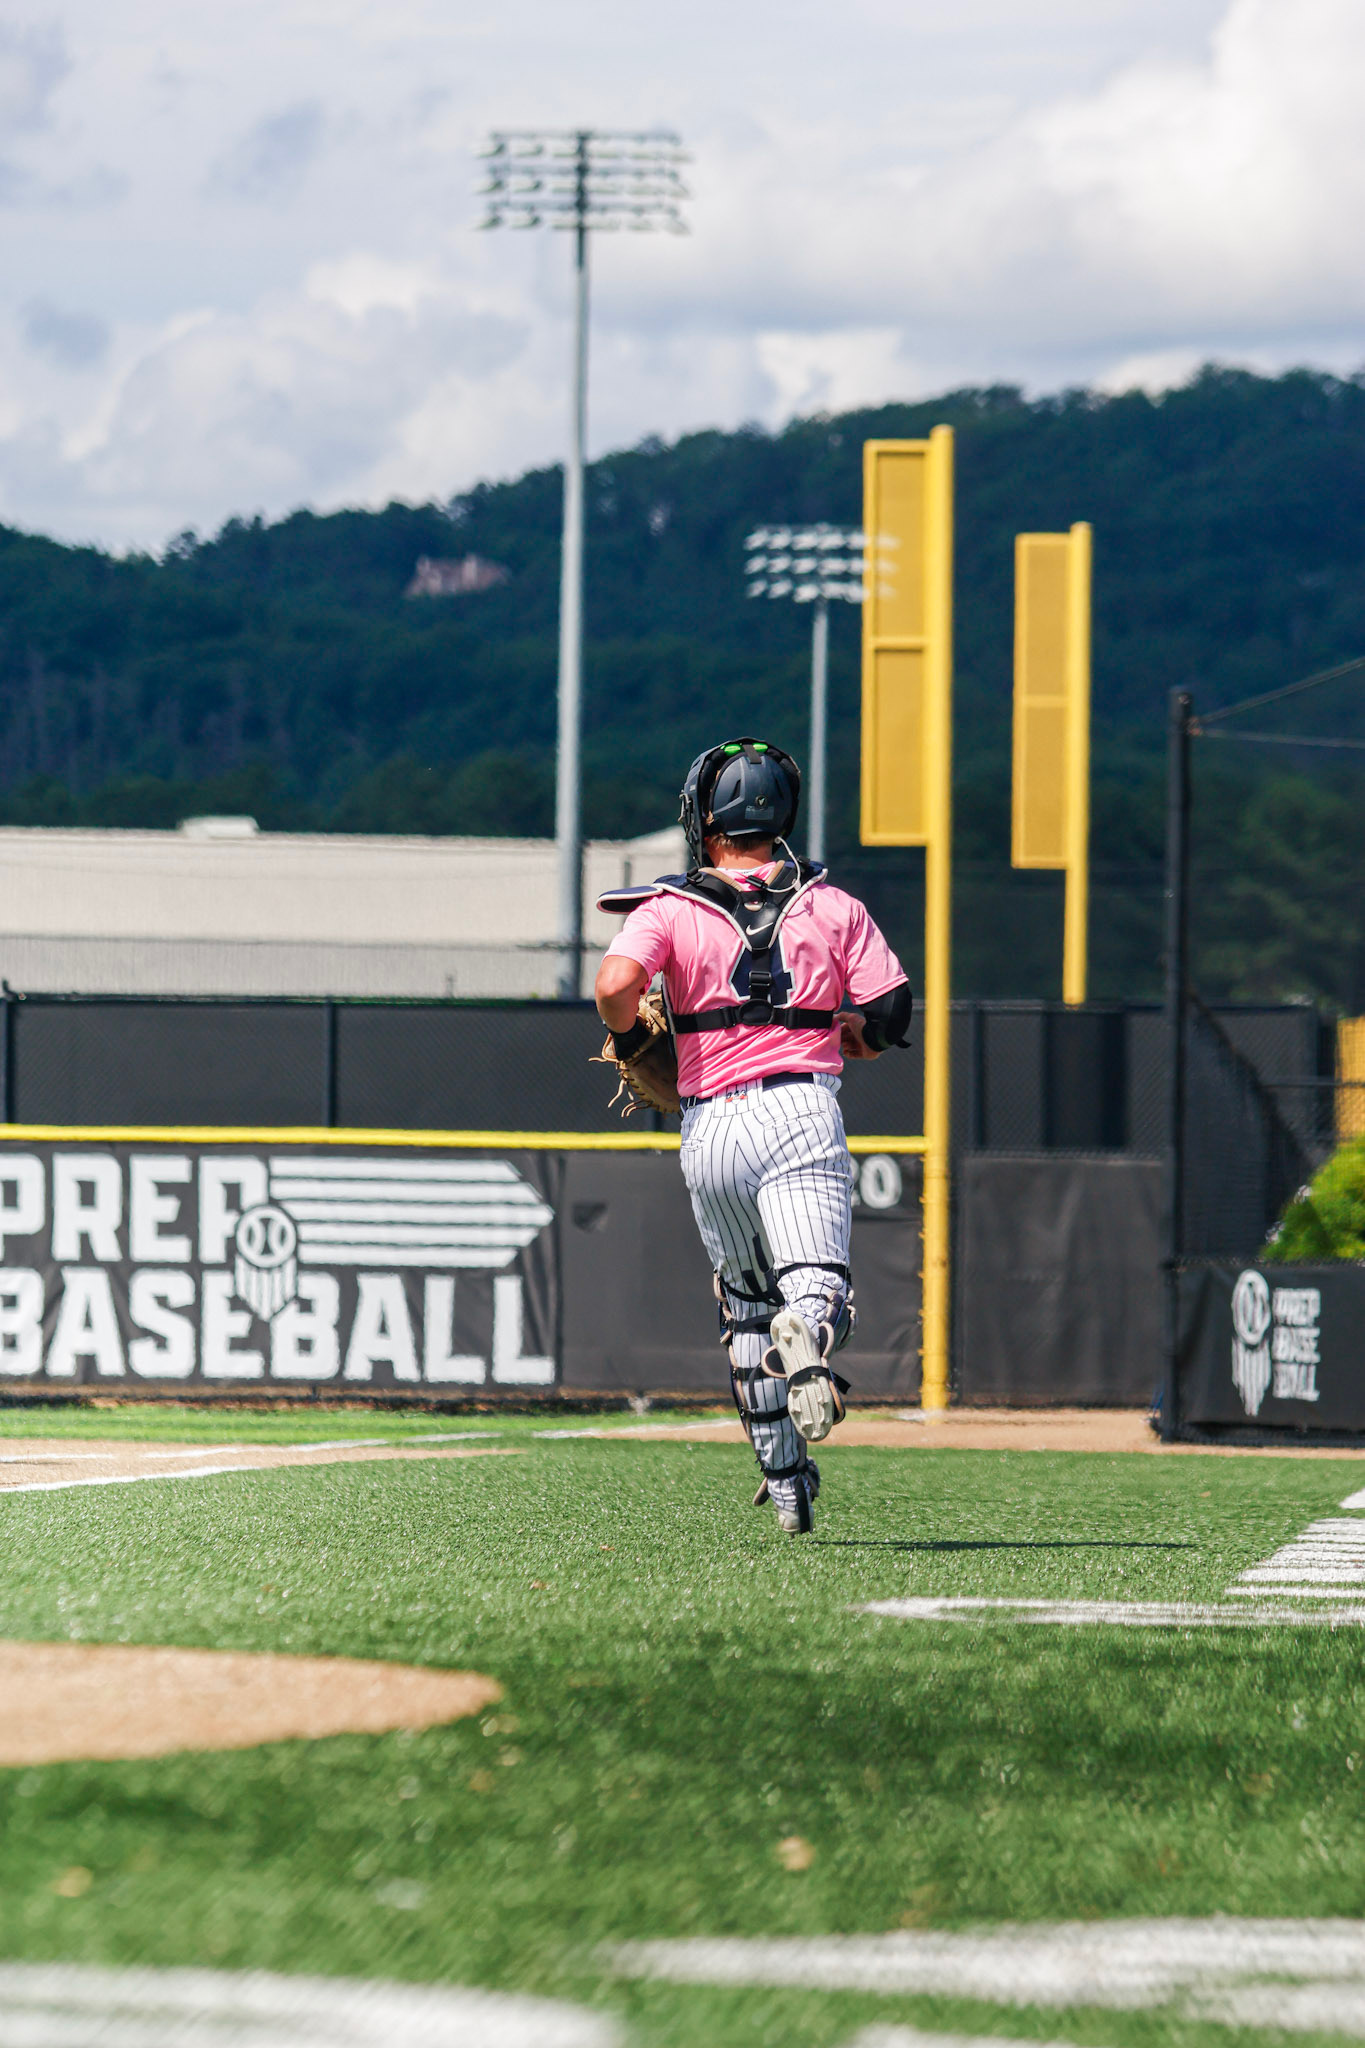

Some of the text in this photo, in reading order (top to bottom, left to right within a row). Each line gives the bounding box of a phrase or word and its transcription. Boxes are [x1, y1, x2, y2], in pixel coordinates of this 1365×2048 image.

[0, 1153, 269, 1263] PREP
[850, 1154, 902, 1210] 0
[0, 1266, 556, 1385] BASEBALL
